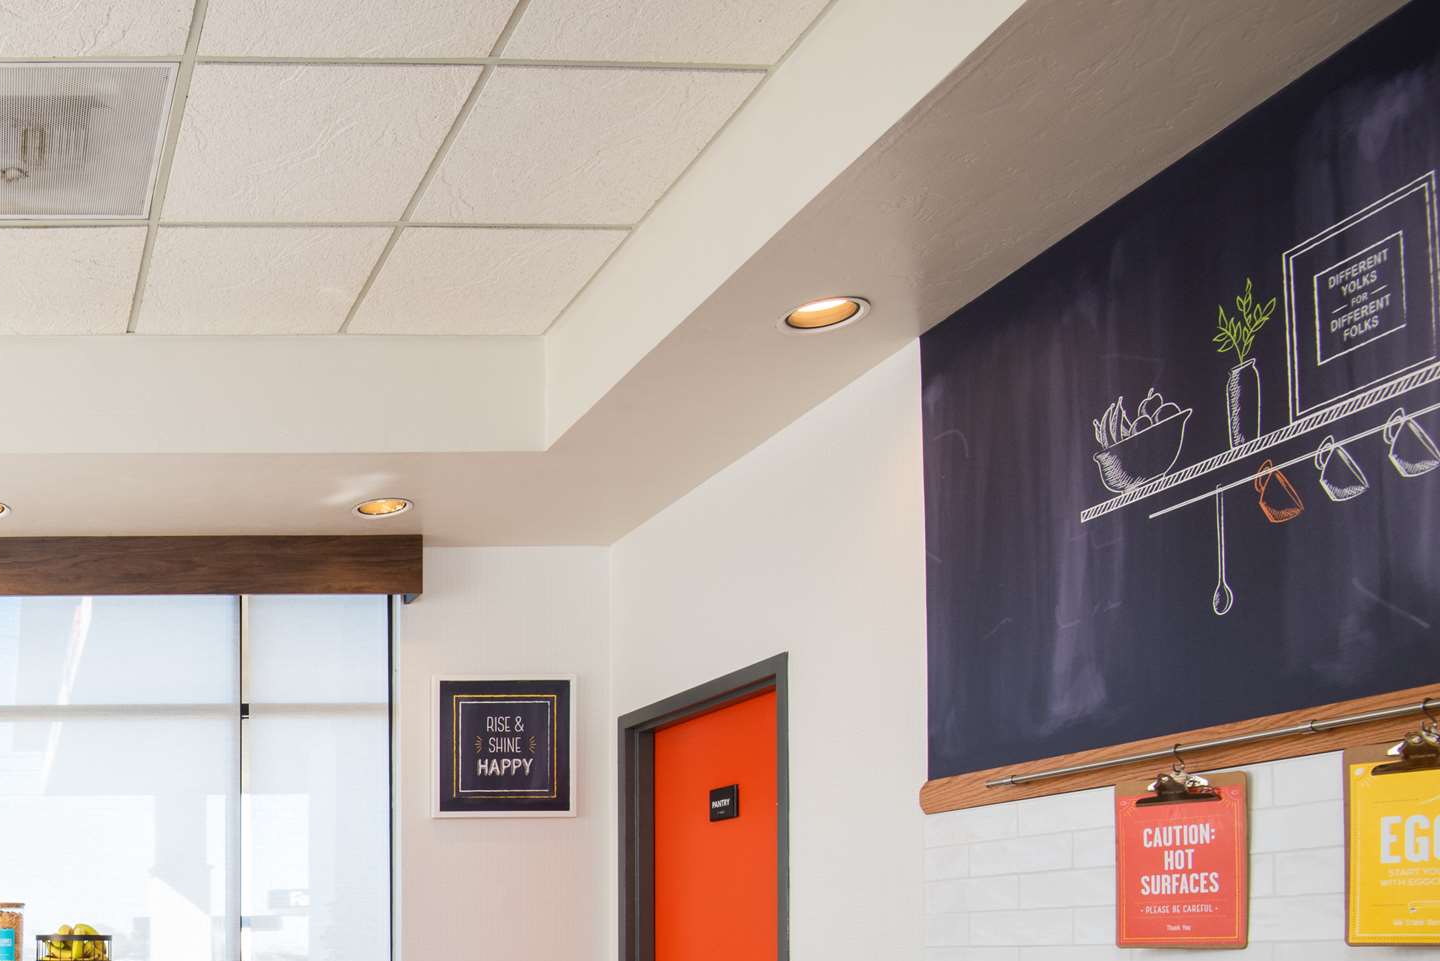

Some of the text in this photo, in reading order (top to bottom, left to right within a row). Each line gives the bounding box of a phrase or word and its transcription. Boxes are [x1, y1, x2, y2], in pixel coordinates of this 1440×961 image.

[1328, 248, 1389, 289] DIFFERENT
[1341, 270, 1377, 296] YOLKS
[1351, 292, 1368, 307] FOR
[1330, 293, 1391, 333] DIFFERENT
[1343, 315, 1379, 342] FOLKS
[486, 715, 525, 732] RISE &
[488, 736, 522, 753] SHINE
[477, 758, 534, 776] HAPPY
[711, 798, 730, 809] PANTRY
[1143, 823, 1215, 848] CAUTION:
[1379, 814, 1440, 865] EG
[1164, 848, 1195, 871] HOT
[1141, 872, 1220, 896] SURFACES
[1145, 904, 1213, 914] PLEASE BE CAREFUL
